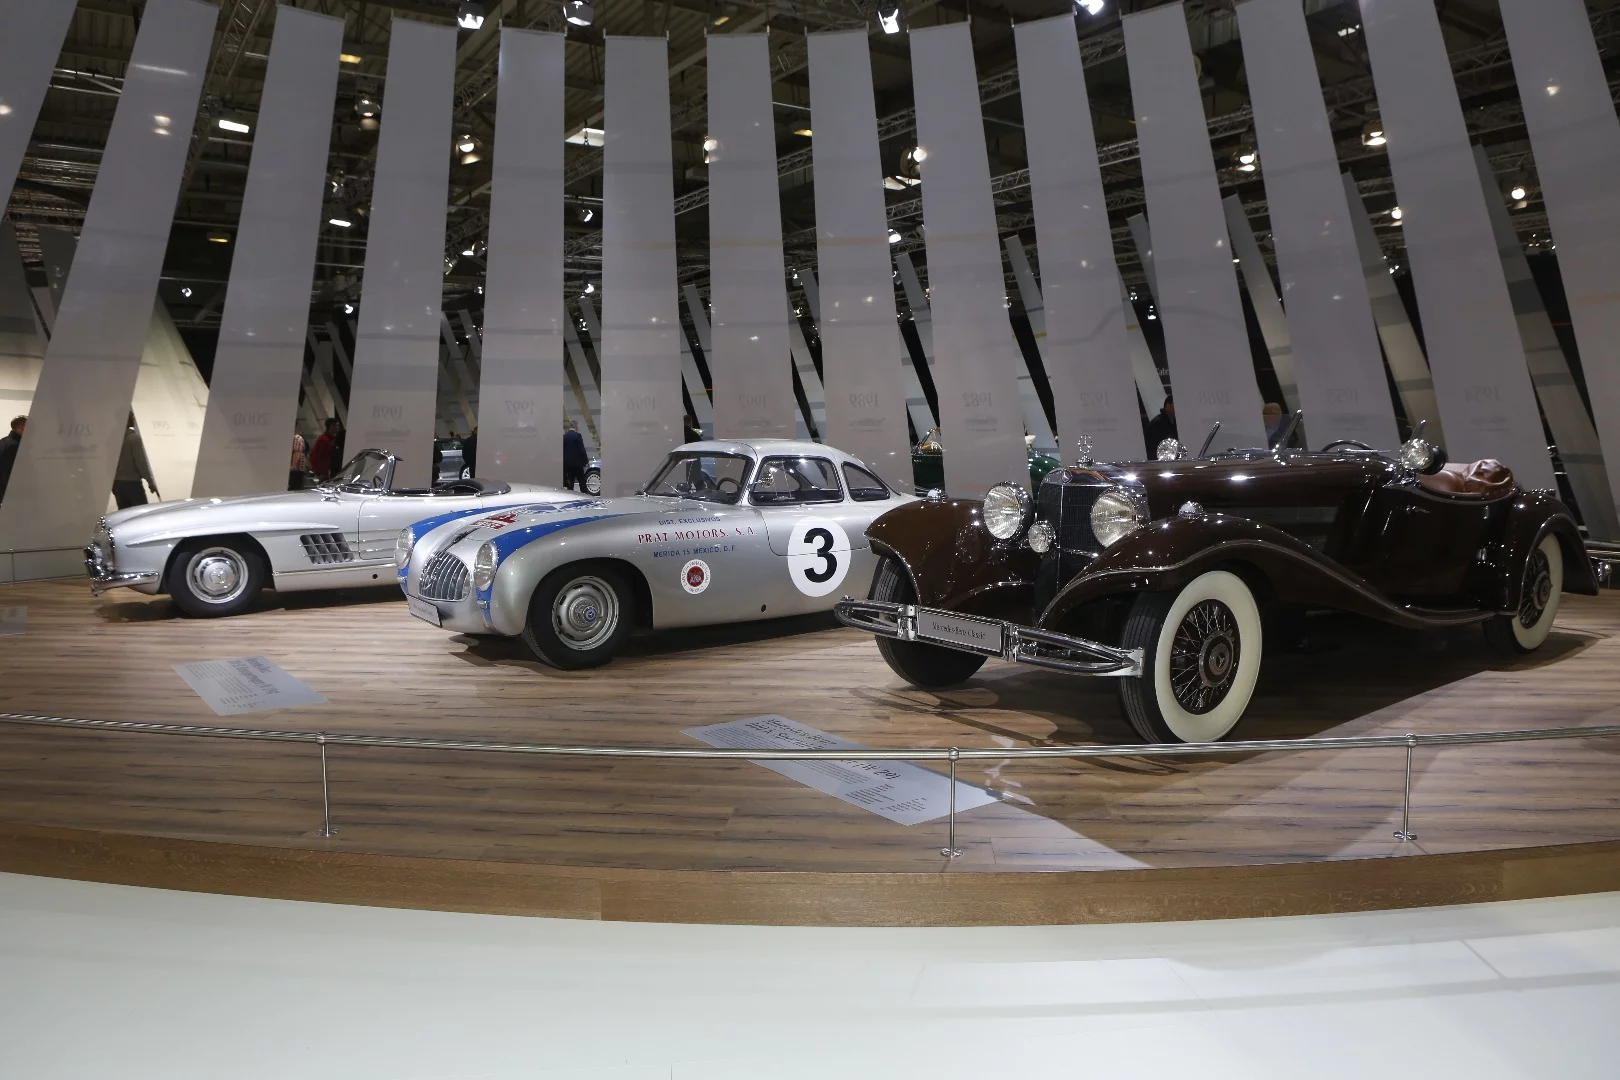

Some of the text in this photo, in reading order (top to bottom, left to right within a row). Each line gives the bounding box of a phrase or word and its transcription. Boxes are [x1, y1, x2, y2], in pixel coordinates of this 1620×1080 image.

[637, 532, 668, 544] PRAT
[653, 549, 680, 558] MERIDA
[803, 527, 838, 584] 3
